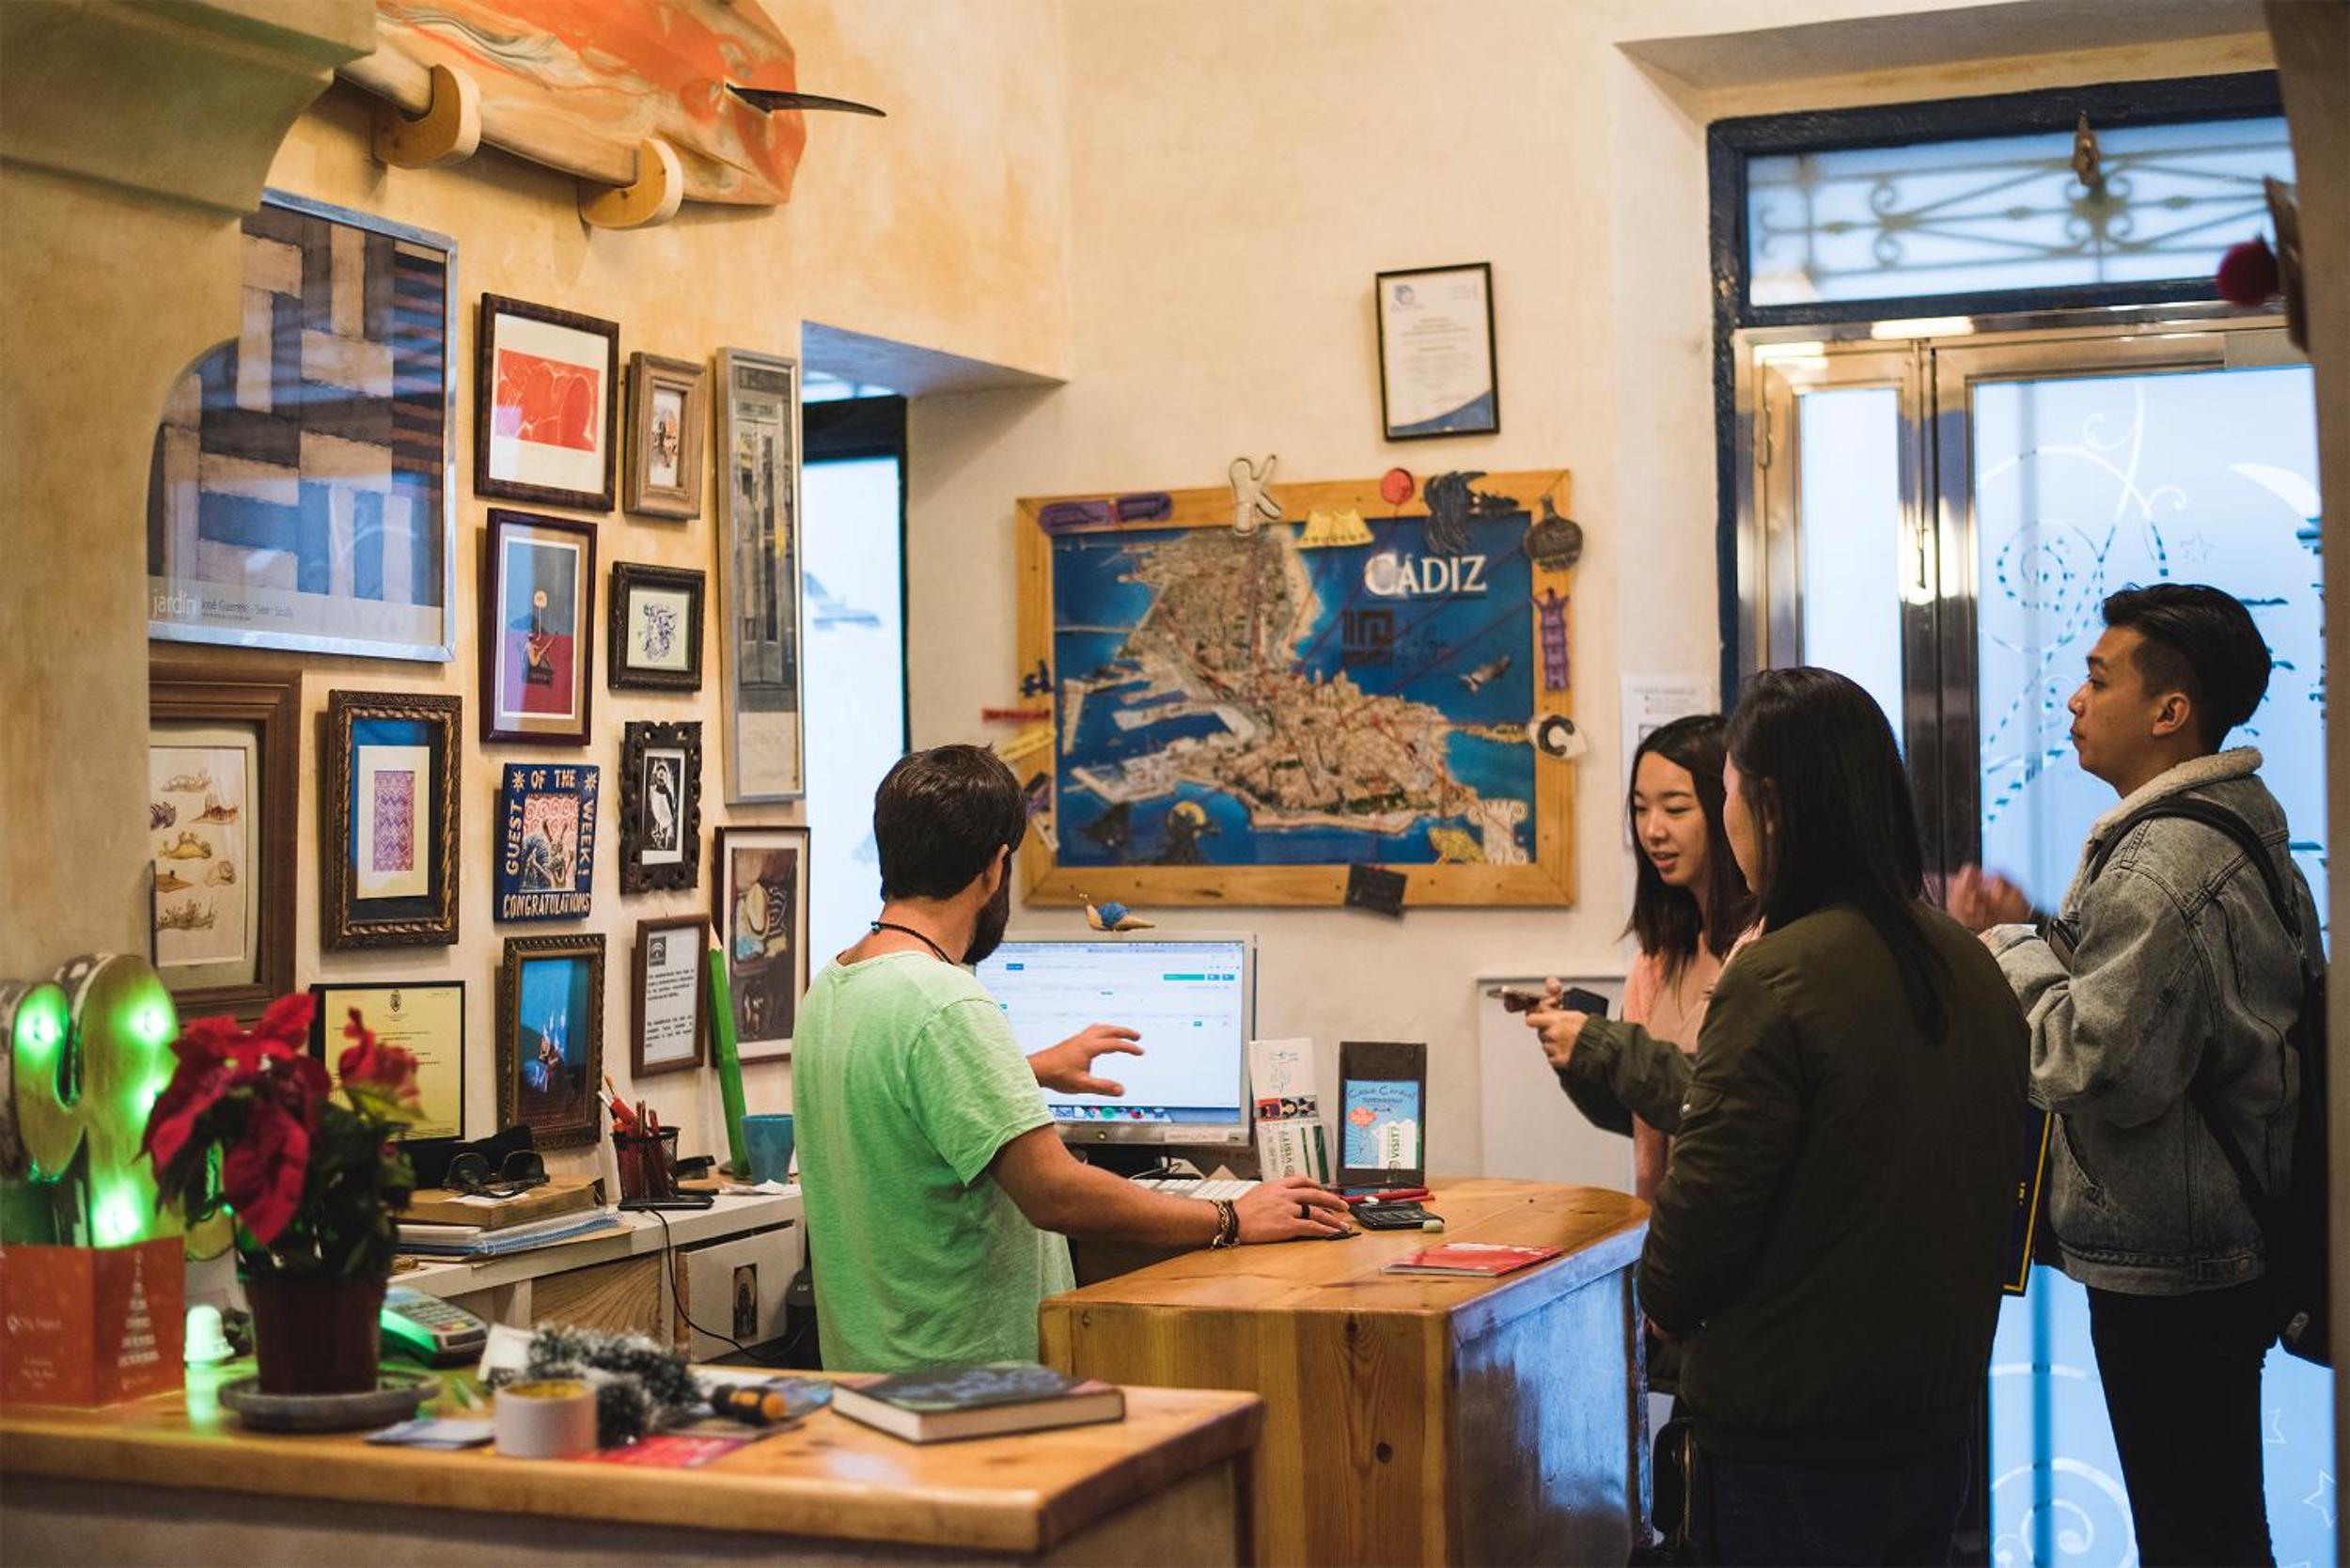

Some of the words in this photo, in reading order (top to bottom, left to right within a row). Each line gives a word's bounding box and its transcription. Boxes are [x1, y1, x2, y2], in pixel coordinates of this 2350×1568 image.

[1365, 551, 1488, 599] CÁDIZ
[530, 770, 547, 789] OF
[554, 768, 577, 789] THE
[506, 799, 523, 876] GUEST
